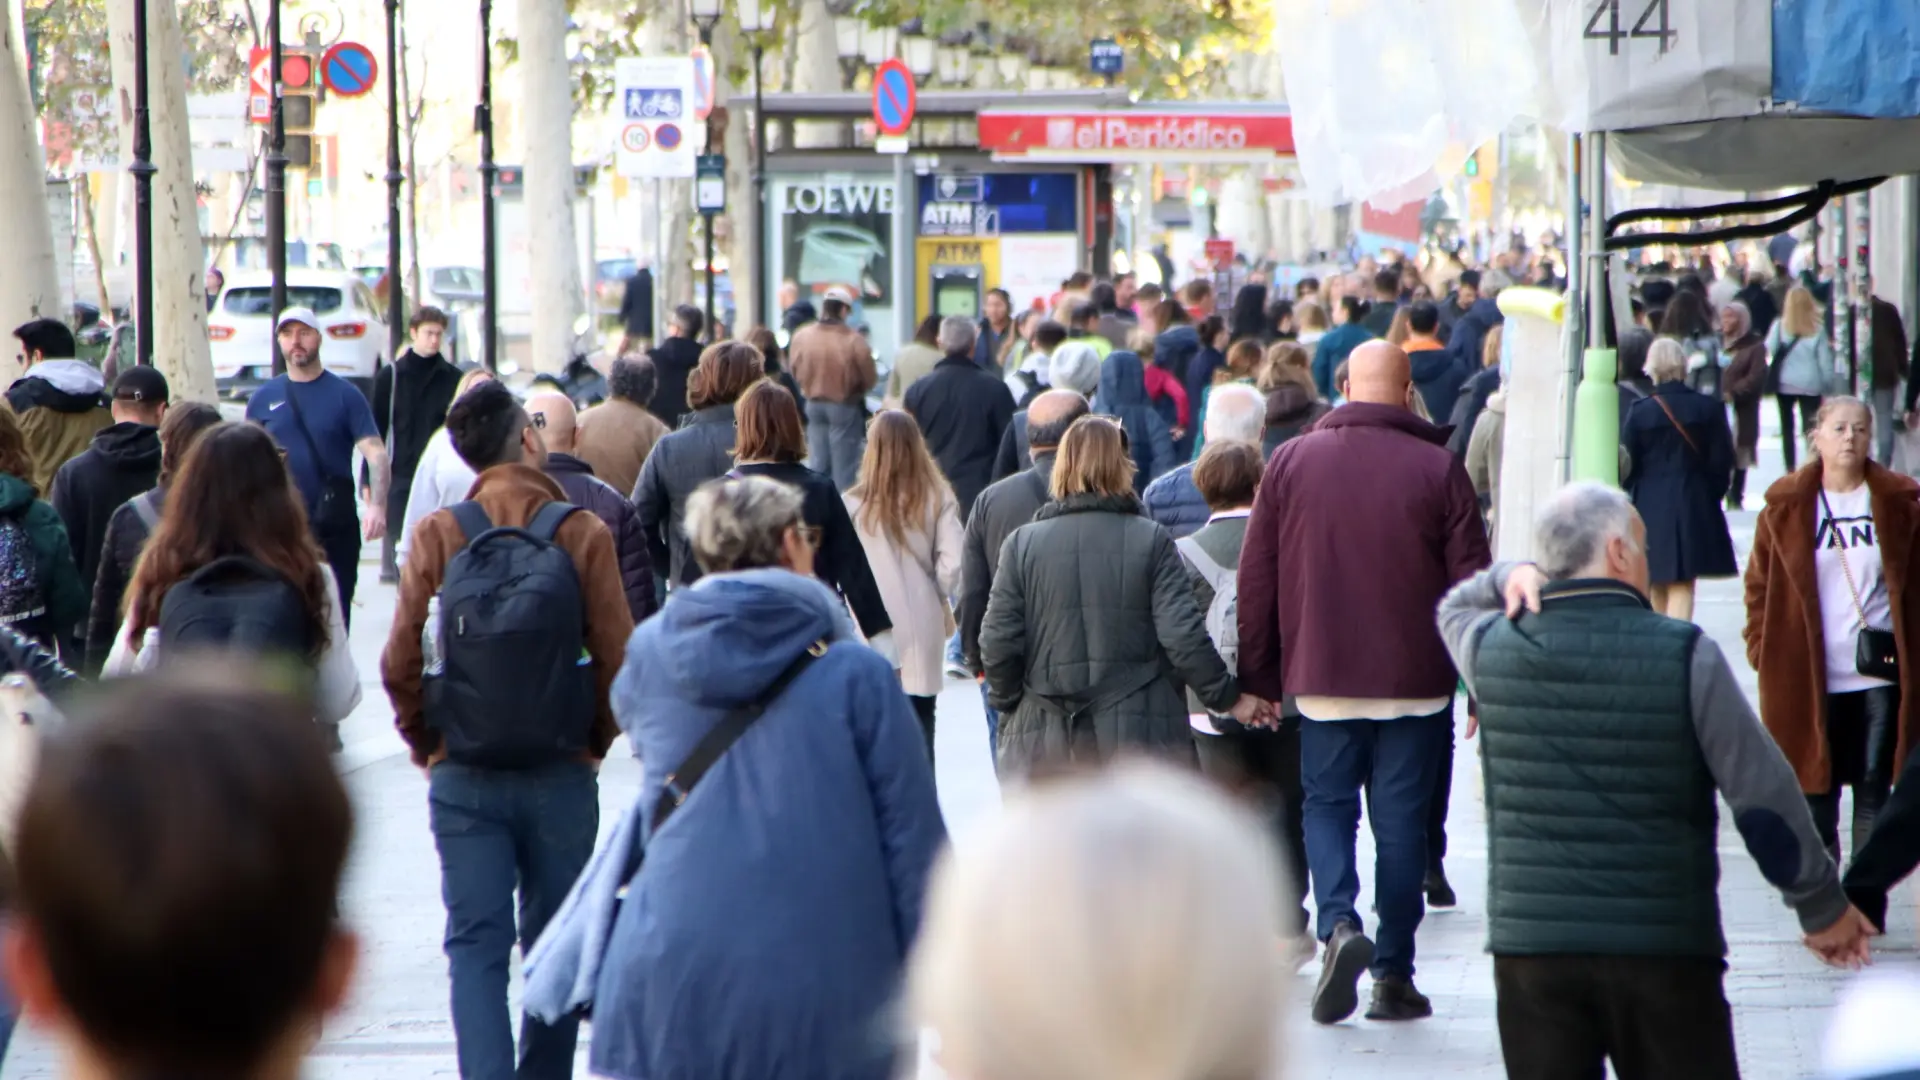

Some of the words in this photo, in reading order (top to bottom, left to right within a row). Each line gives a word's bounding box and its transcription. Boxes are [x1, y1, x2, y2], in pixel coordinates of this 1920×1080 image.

[1583, 0, 1677, 56] 44
[629, 132, 646, 145] 10
[1076, 118, 1102, 149] el
[1105, 117, 1246, 149] Periódico
[780, 183, 900, 214] LOEWE
[923, 202, 972, 225] ATM
[936, 243, 981, 261] ATM
